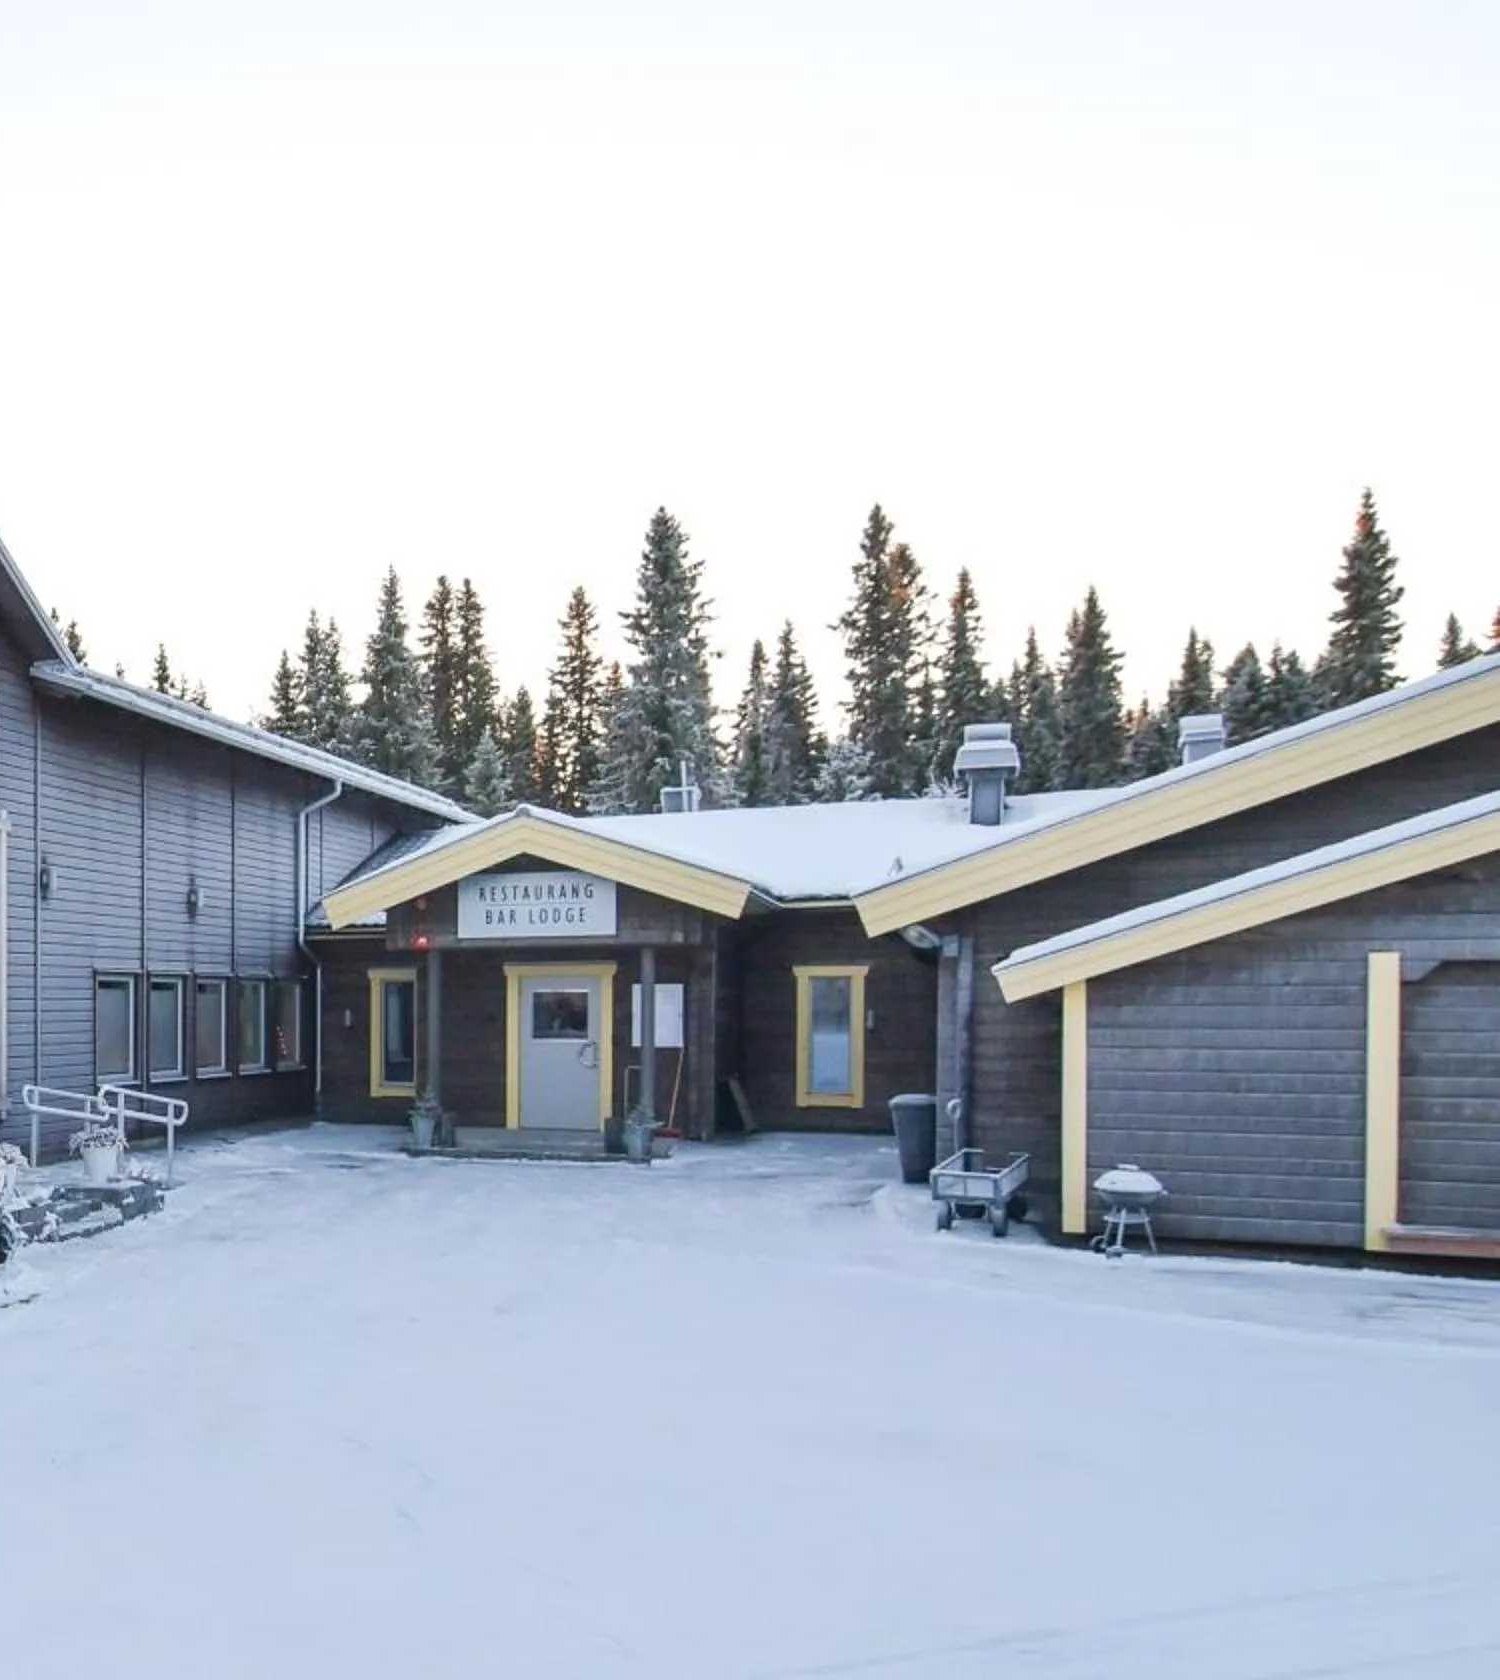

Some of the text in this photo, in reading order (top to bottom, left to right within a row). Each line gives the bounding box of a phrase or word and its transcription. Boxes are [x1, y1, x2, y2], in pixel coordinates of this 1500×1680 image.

[479, 883, 594, 902] RESTAURANG
[485, 907, 586, 925] BAR LODGE
